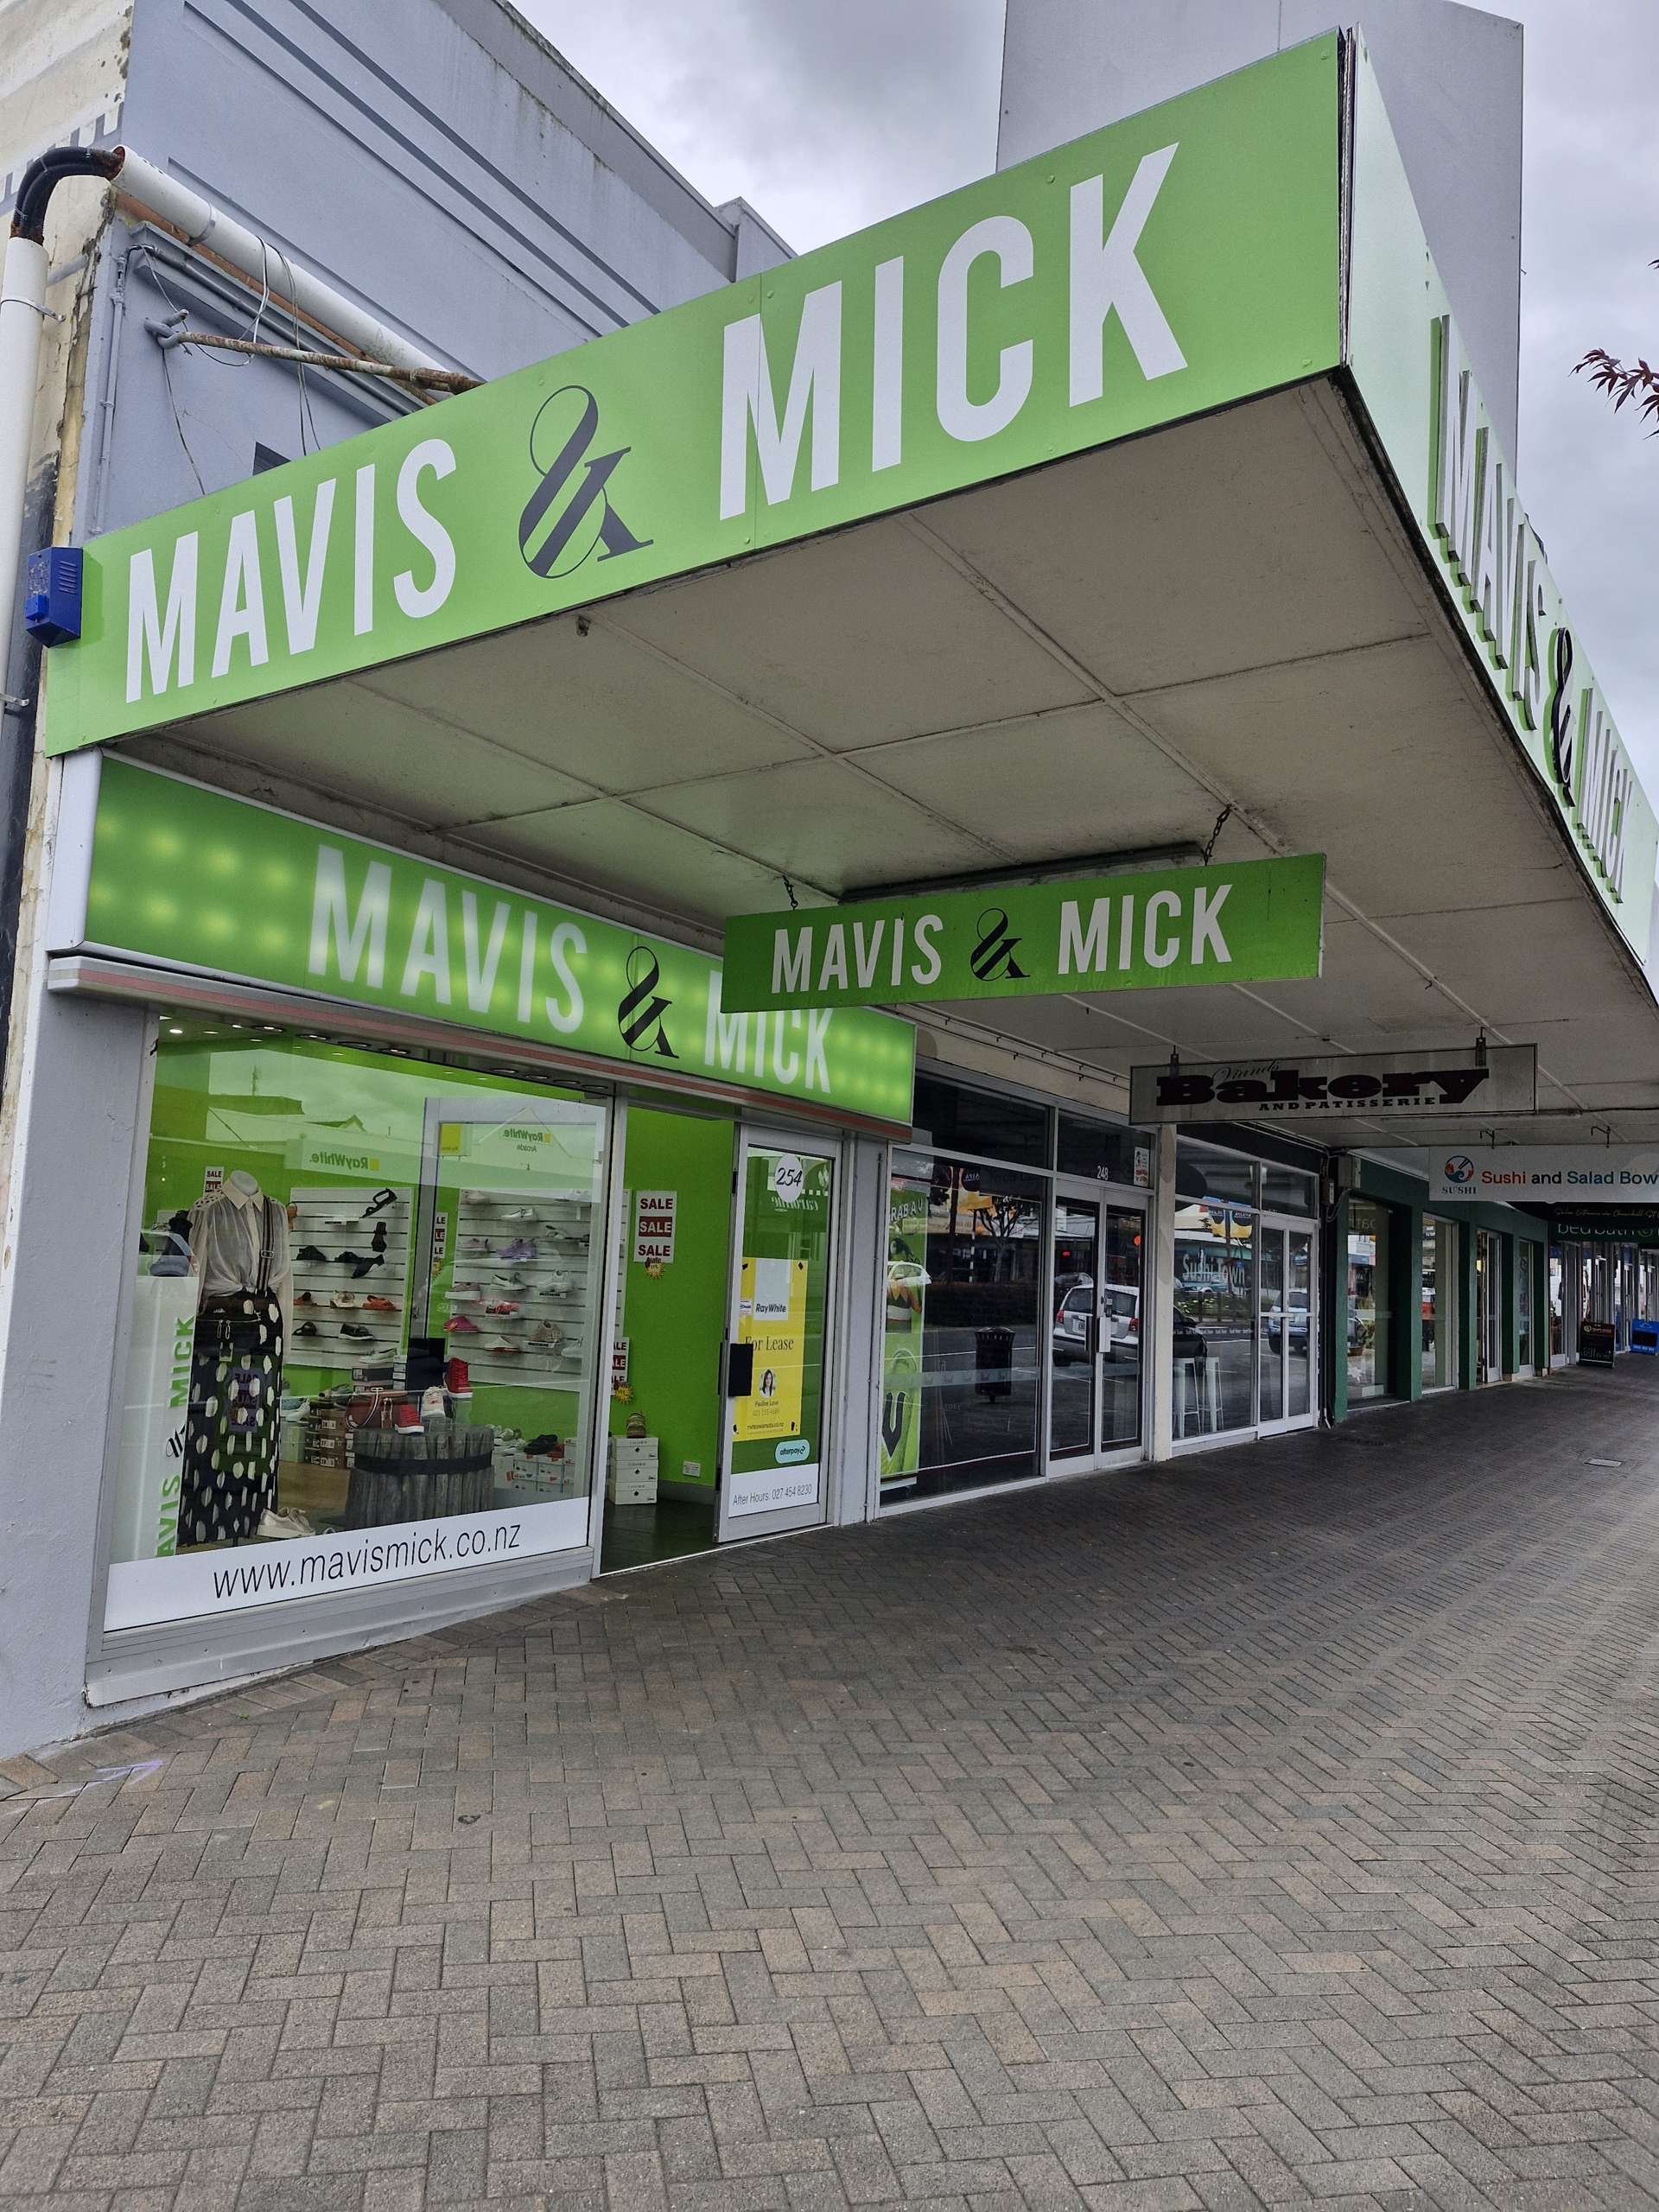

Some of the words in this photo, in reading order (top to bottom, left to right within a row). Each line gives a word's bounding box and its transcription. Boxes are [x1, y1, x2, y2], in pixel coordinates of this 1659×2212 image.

[126, 438, 457, 704] MAVIS
[518, 385, 654, 580] &
[720, 142, 1188, 520] MICK
[1427, 314, 1548, 731] MAVIS
[1572, 688, 1632, 904] MICK
[771, 914, 944, 994] MAVIS
[969, 907, 1031, 982] &
[1057, 883, 1234, 976] MICK
[308, 843, 588, 1034] MAVIS
[617, 945, 680, 1059] &
[704, 969, 831, 1094] MICK
[1156, 1068, 1490, 1107] Bakery
[1259, 1103, 1299, 1111] AND
[1306, 1097, 1436, 1109] PATISSERIE
[776, 1167, 803, 1187] 254
[1096, 1165, 1109, 1181] 248
[1481, 1171, 1527, 1185] Sushi
[1531, 1171, 1562, 1185] and
[1567, 1170, 1614, 1185] Salad
[640, 1198, 674, 1210] SALE
[639, 1221, 672, 1233] SALE
[638, 1244, 671, 1257] SALE
[766, 1336, 794, 1351] Lease
[169, 1314, 195, 1409] MICK
[732, 1493, 749, 1506] After
[772, 1488, 784, 1500] 027
[785, 1486, 796, 1497] 454
[797, 1484, 812, 1496] 8230
[156, 1473, 181, 1556] AVIS
[213, 1523, 522, 1599] www.mavismick.co.nz
